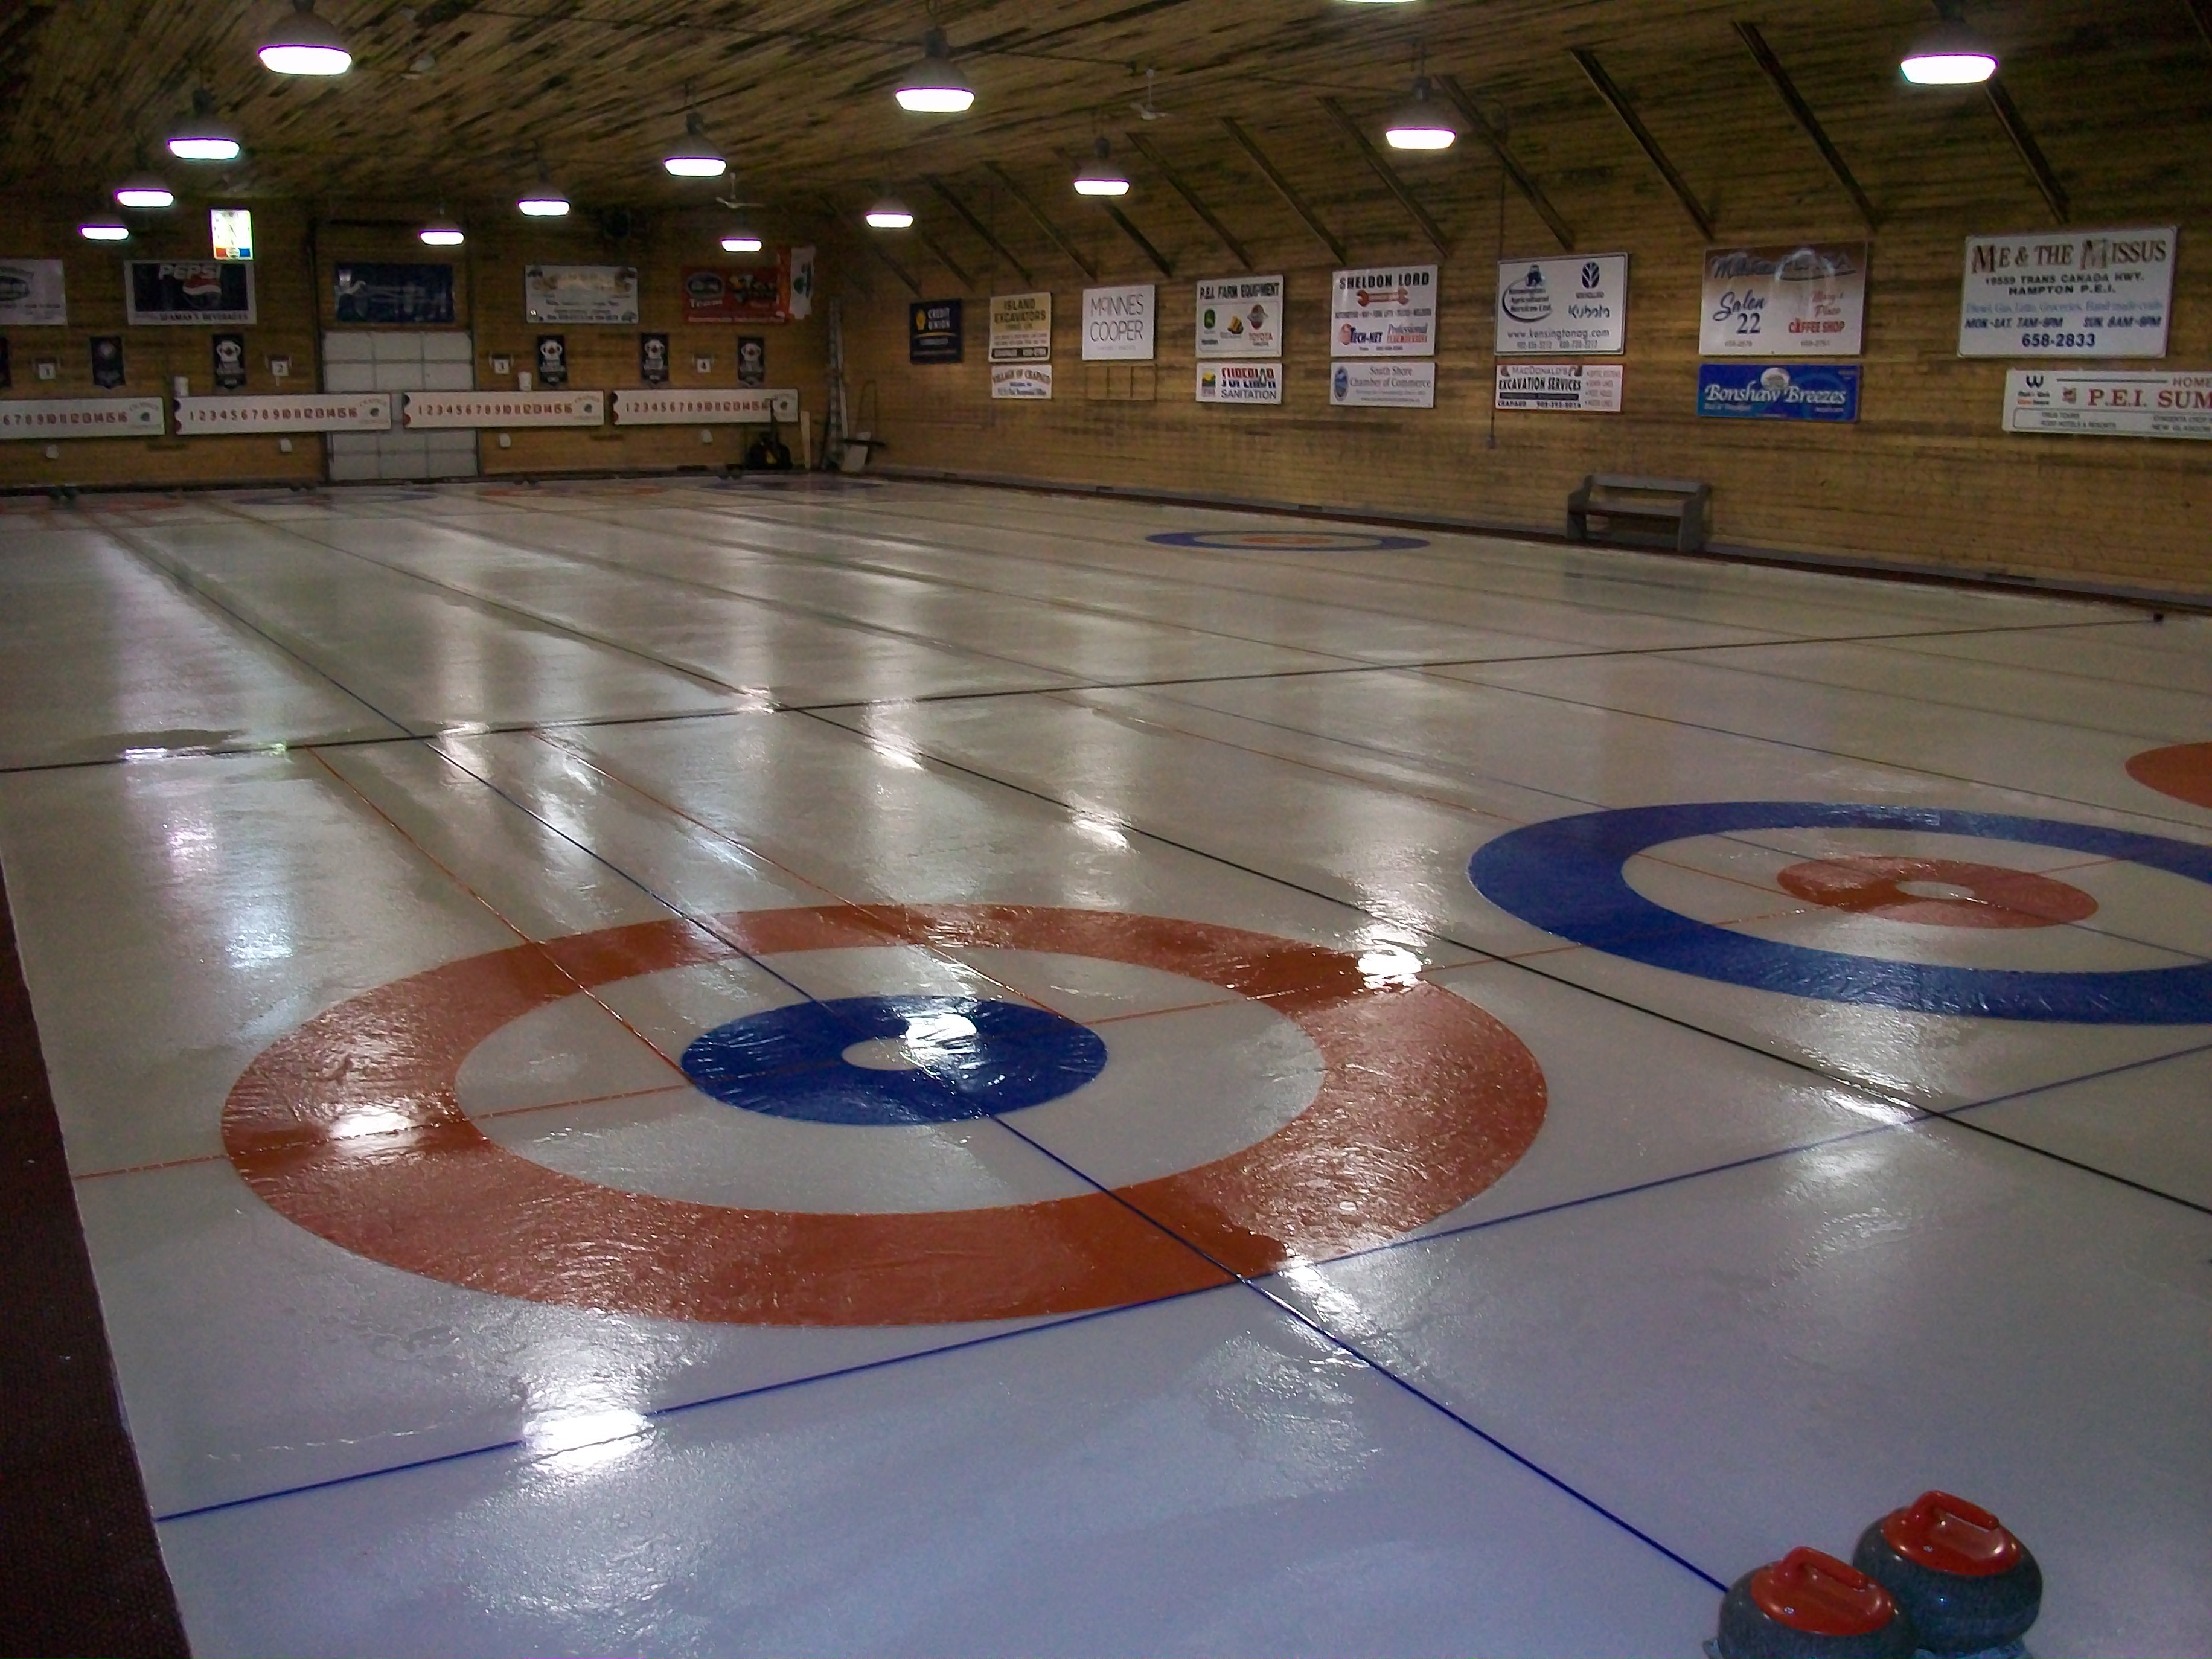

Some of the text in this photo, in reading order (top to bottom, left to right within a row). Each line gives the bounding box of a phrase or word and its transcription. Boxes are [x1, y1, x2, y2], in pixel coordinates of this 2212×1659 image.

[1971, 238, 2167, 273] ME & THE MISSUS
[159, 263, 222, 280] PEPSI
[2020, 274, 2056, 284] TRANS
[2060, 273, 2109, 283] CANADA
[1338, 274, 1393, 290] SHELDON
[2008, 285, 2074, 296] HAMPTON
[1003, 298, 1036, 311] ISLAND
[1568, 304, 1611, 319] Kubota
[994, 310, 1047, 324] EXCAVATORS
[1736, 312, 1761, 334] 22
[1090, 319, 1144, 342] COOPER
[1391, 378, 1431, 388] Commerce
[1498, 377, 1546, 391] EXCAVATION
[1547, 377, 1581, 391] SERVICES
[1221, 389, 1277, 400] SANITATION
[1704, 380, 1847, 405] Bonshaw Breezes
